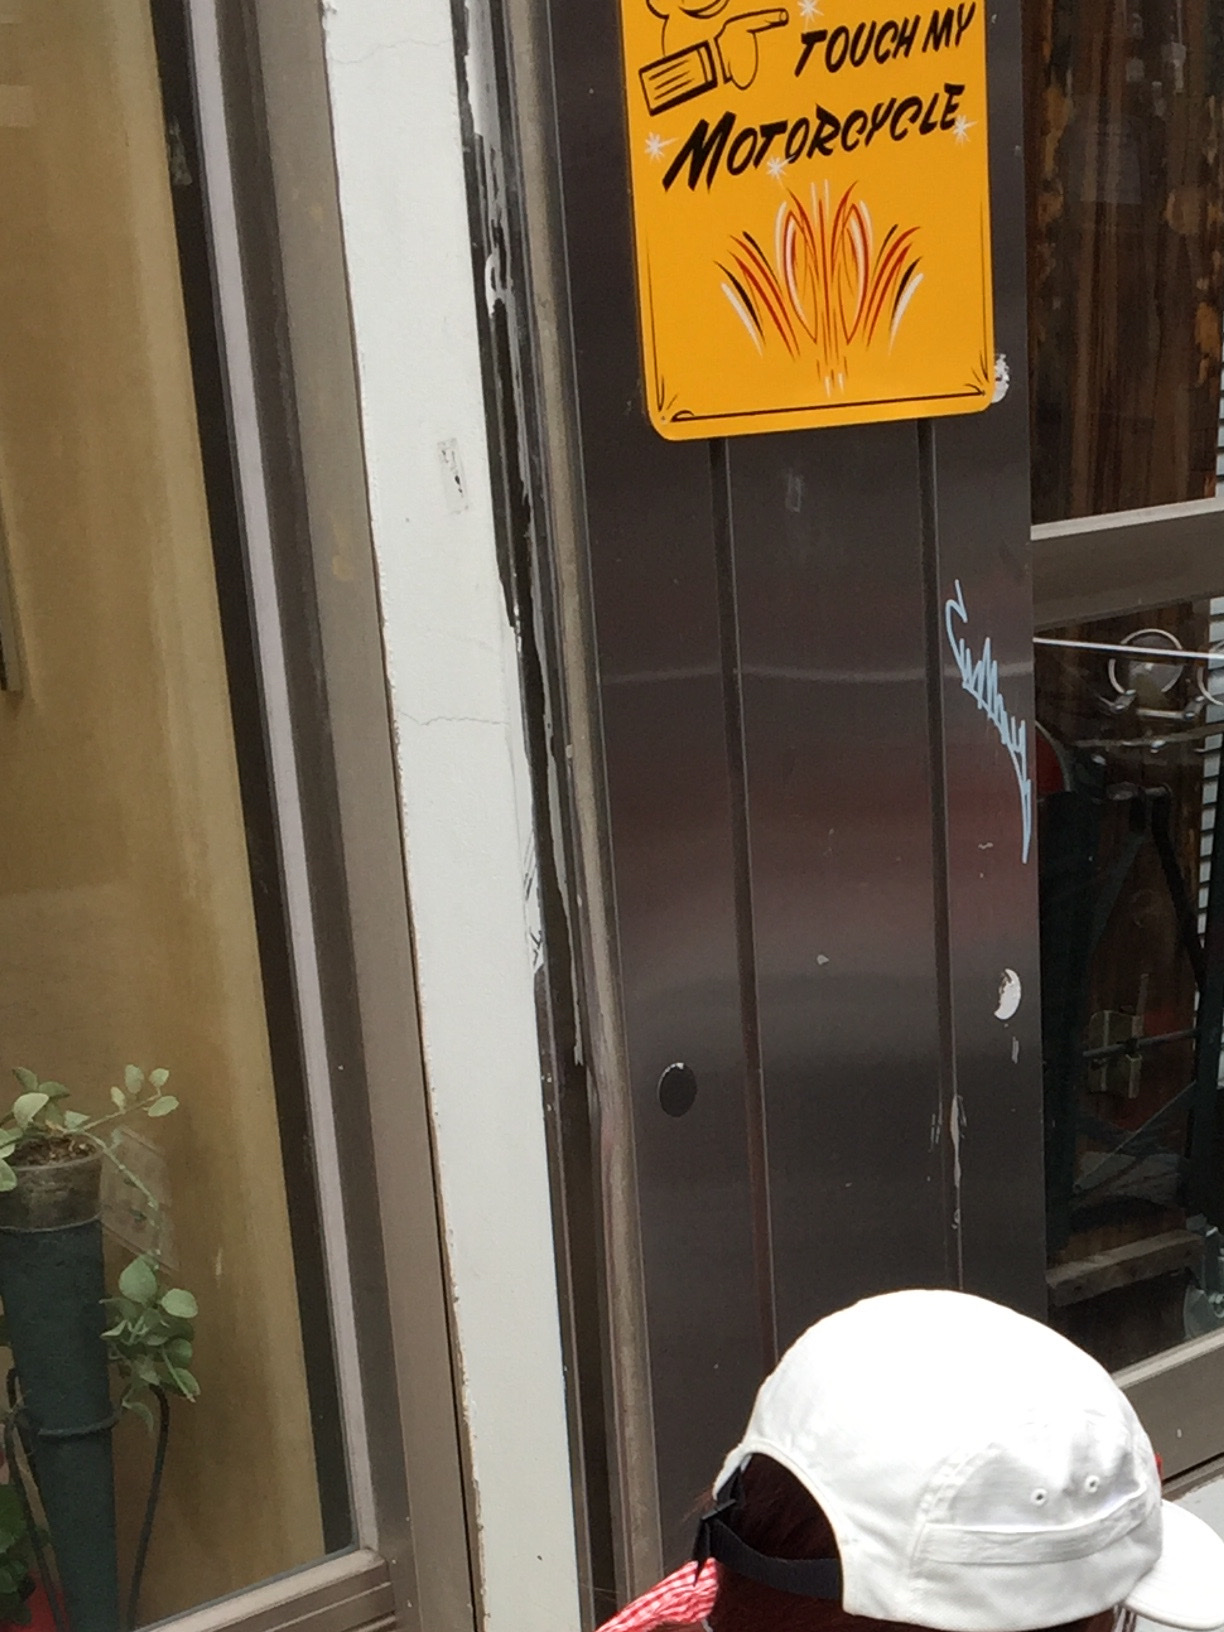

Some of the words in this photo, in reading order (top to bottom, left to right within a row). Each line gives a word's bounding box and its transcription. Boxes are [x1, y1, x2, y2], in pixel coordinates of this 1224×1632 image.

[794, 14, 921, 77] TOUCH
[922, 1, 976, 53] MY
[662, 82, 966, 192] MOTORCYCLE
